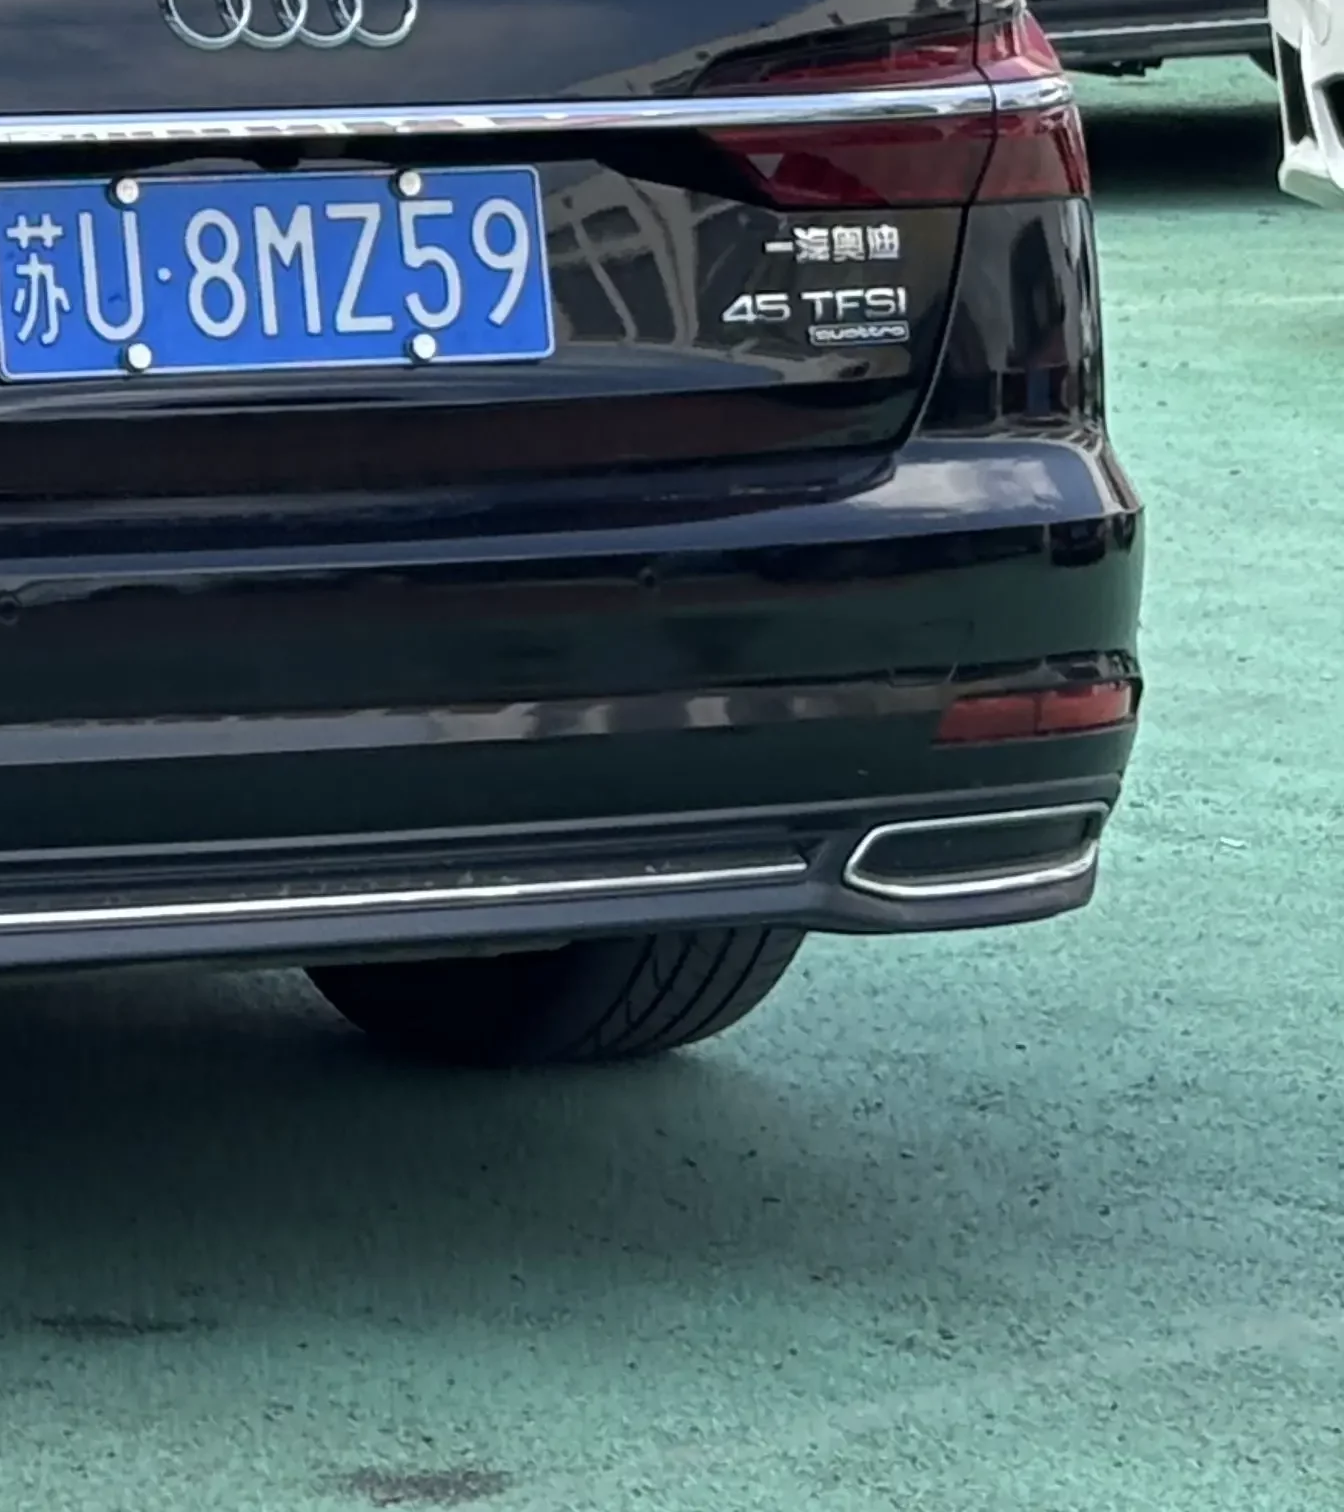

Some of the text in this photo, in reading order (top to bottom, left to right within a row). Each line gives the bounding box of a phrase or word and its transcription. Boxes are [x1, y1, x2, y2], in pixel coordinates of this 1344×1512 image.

[764, 223, 900, 264] 一汽奥迪
[721, 286, 908, 323] 45 TFSI
[815, 324, 906, 341] quattro
